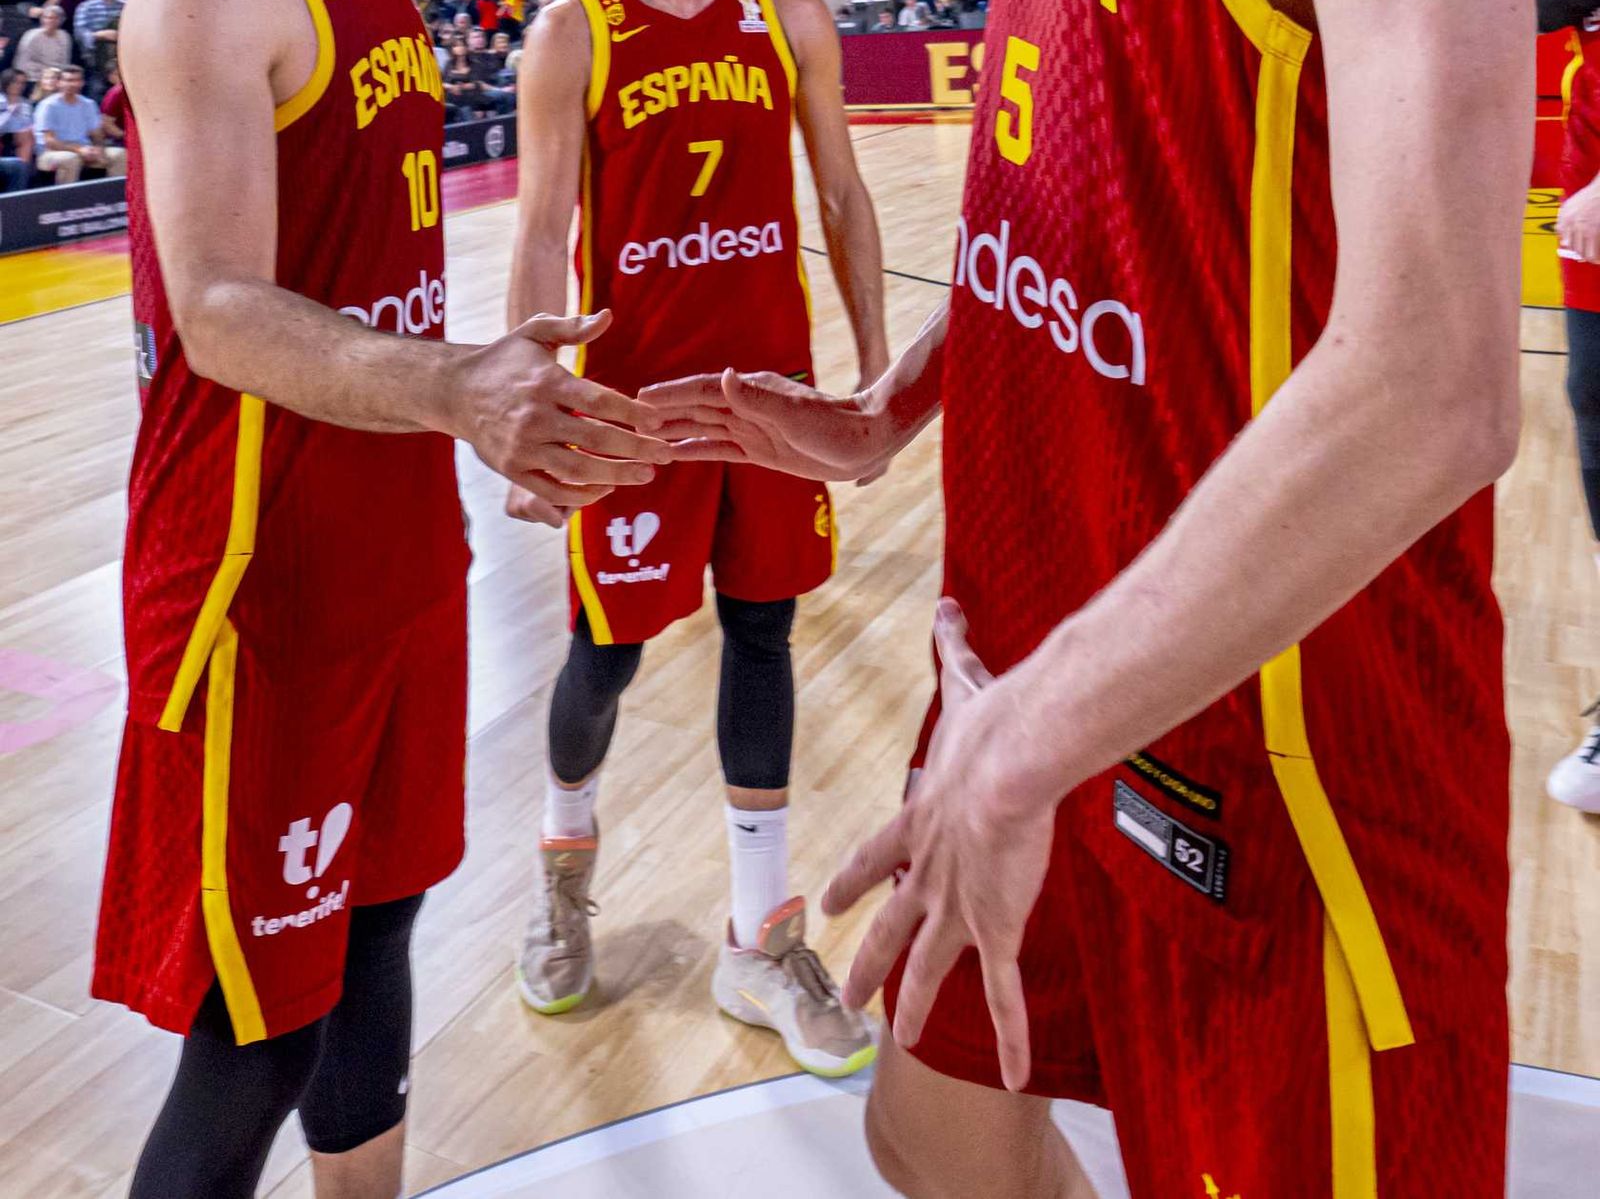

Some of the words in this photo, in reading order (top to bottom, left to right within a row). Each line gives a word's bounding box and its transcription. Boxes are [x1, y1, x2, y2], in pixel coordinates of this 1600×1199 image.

[350, 32, 444, 130] ESPAÑ
[618, 55, 774, 129] ESPAÑA
[995, 35, 1040, 166] 5
[402, 150, 439, 231] 10
[688, 140, 724, 197] 7
[618, 221, 784, 275] endesa
[1174, 838, 1205, 874] 52
